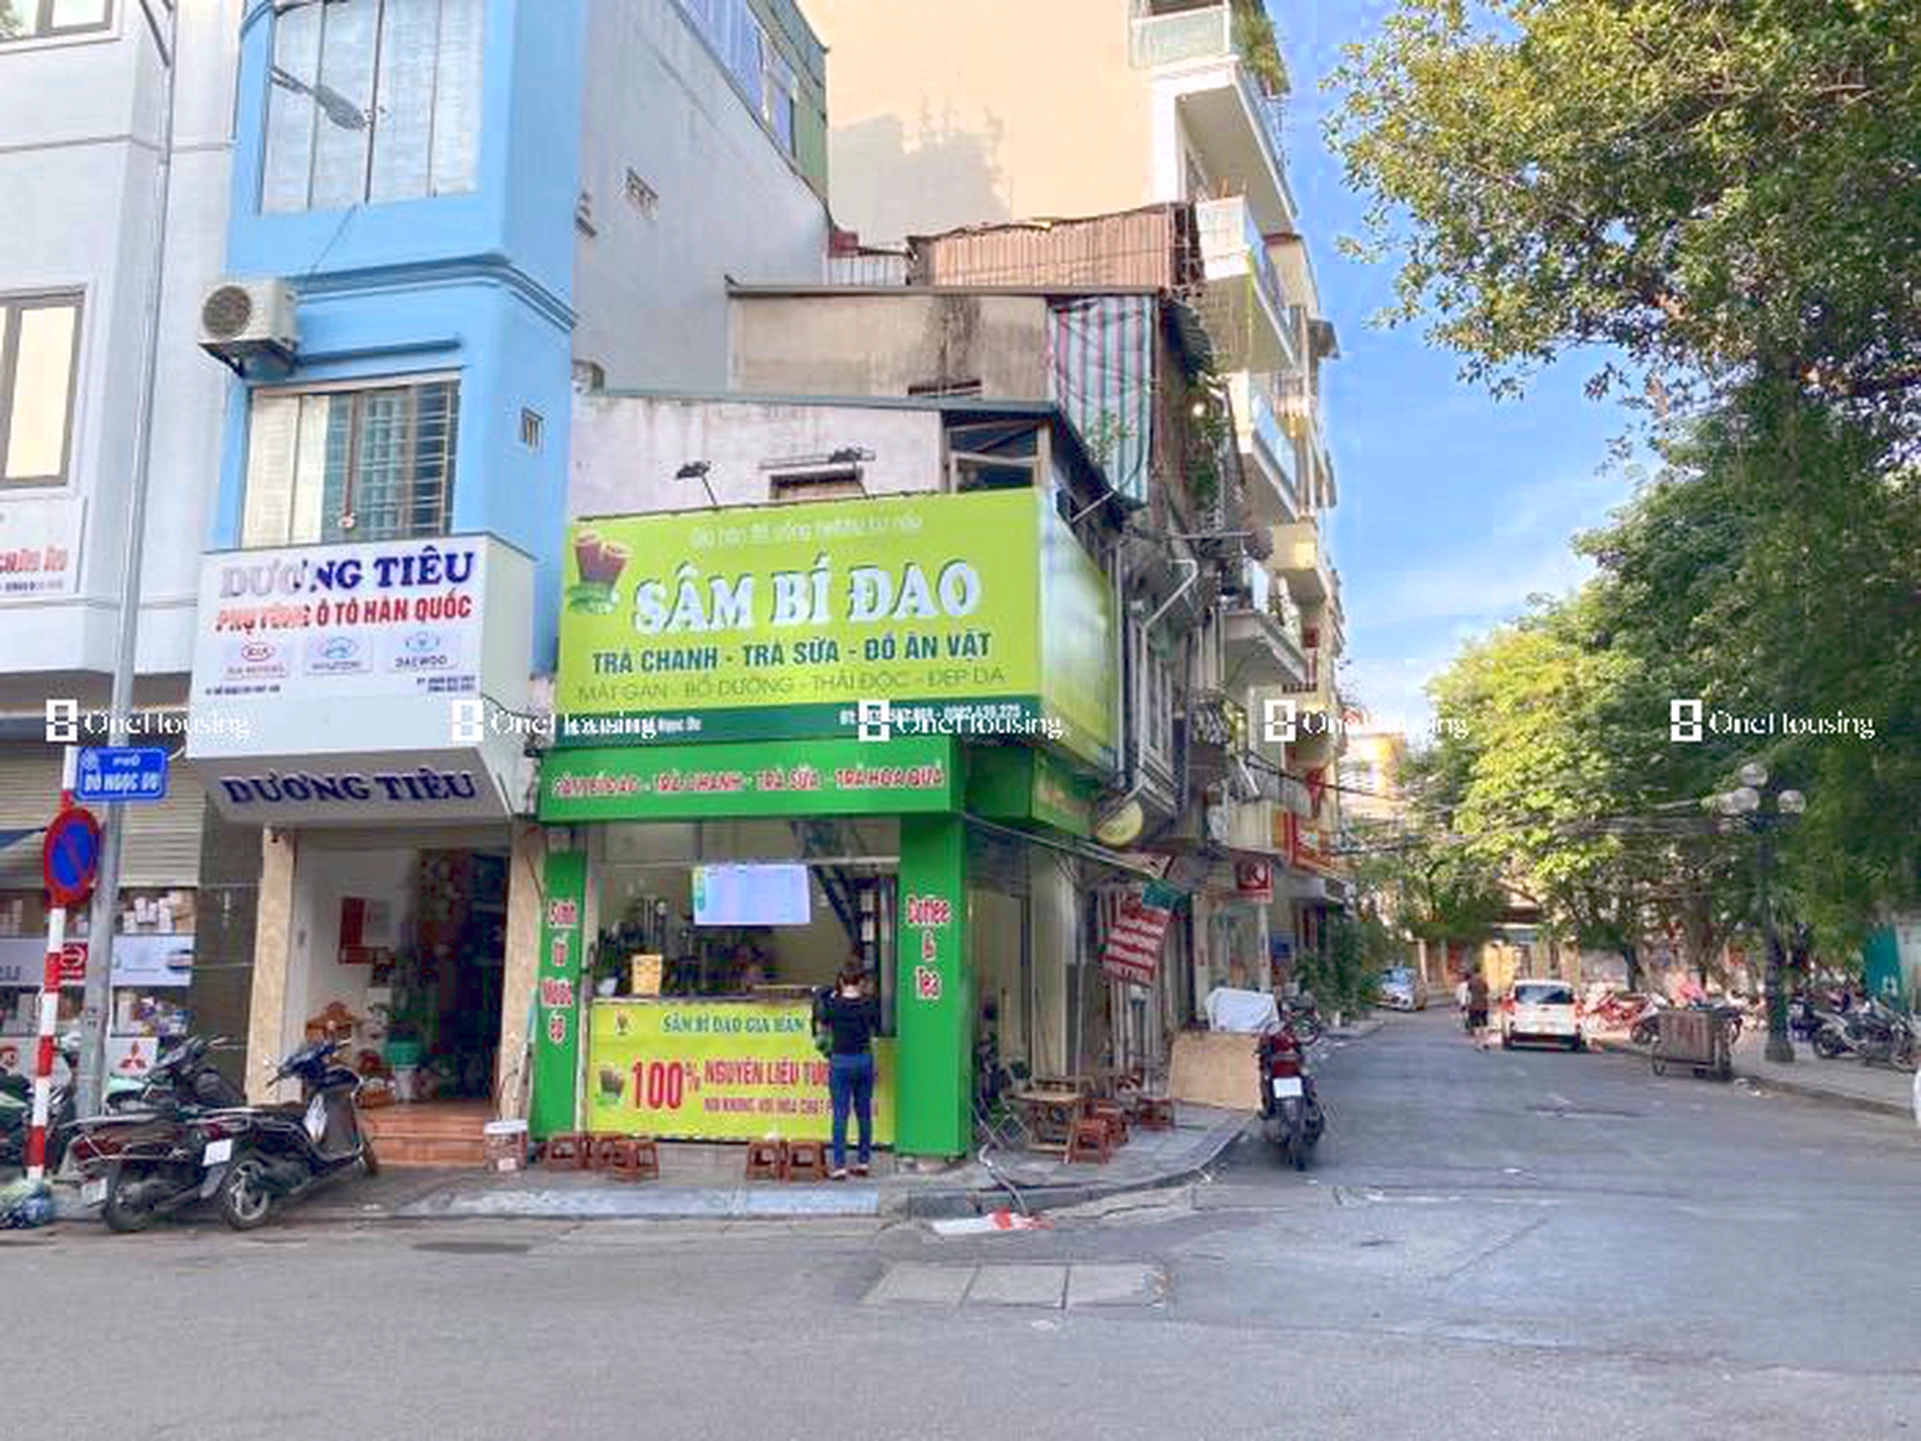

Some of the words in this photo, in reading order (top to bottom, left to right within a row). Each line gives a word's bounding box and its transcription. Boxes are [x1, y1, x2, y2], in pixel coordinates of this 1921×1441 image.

[219, 559, 364, 598] DƯƠNG
[373, 545, 475, 588] TIÊU
[634, 561, 754, 635] SÂM
[771, 551, 832, 625] BÍ
[848, 557, 982, 624] ĐAO
[414, 588, 473, 621] QUỐC
[592, 649, 633, 675] TRÀ
[641, 647, 718, 673] CHANH
[742, 642, 785, 668] TRÀ
[793, 636, 839, 665] SỮA
[864, 633, 896, 662] ĐỒ
[904, 632, 938, 661] ĂN
[220, 768, 371, 803] DƯƠNG
[373, 765, 476, 800] TIÊU
[631, 1059, 701, 1110] 100%
